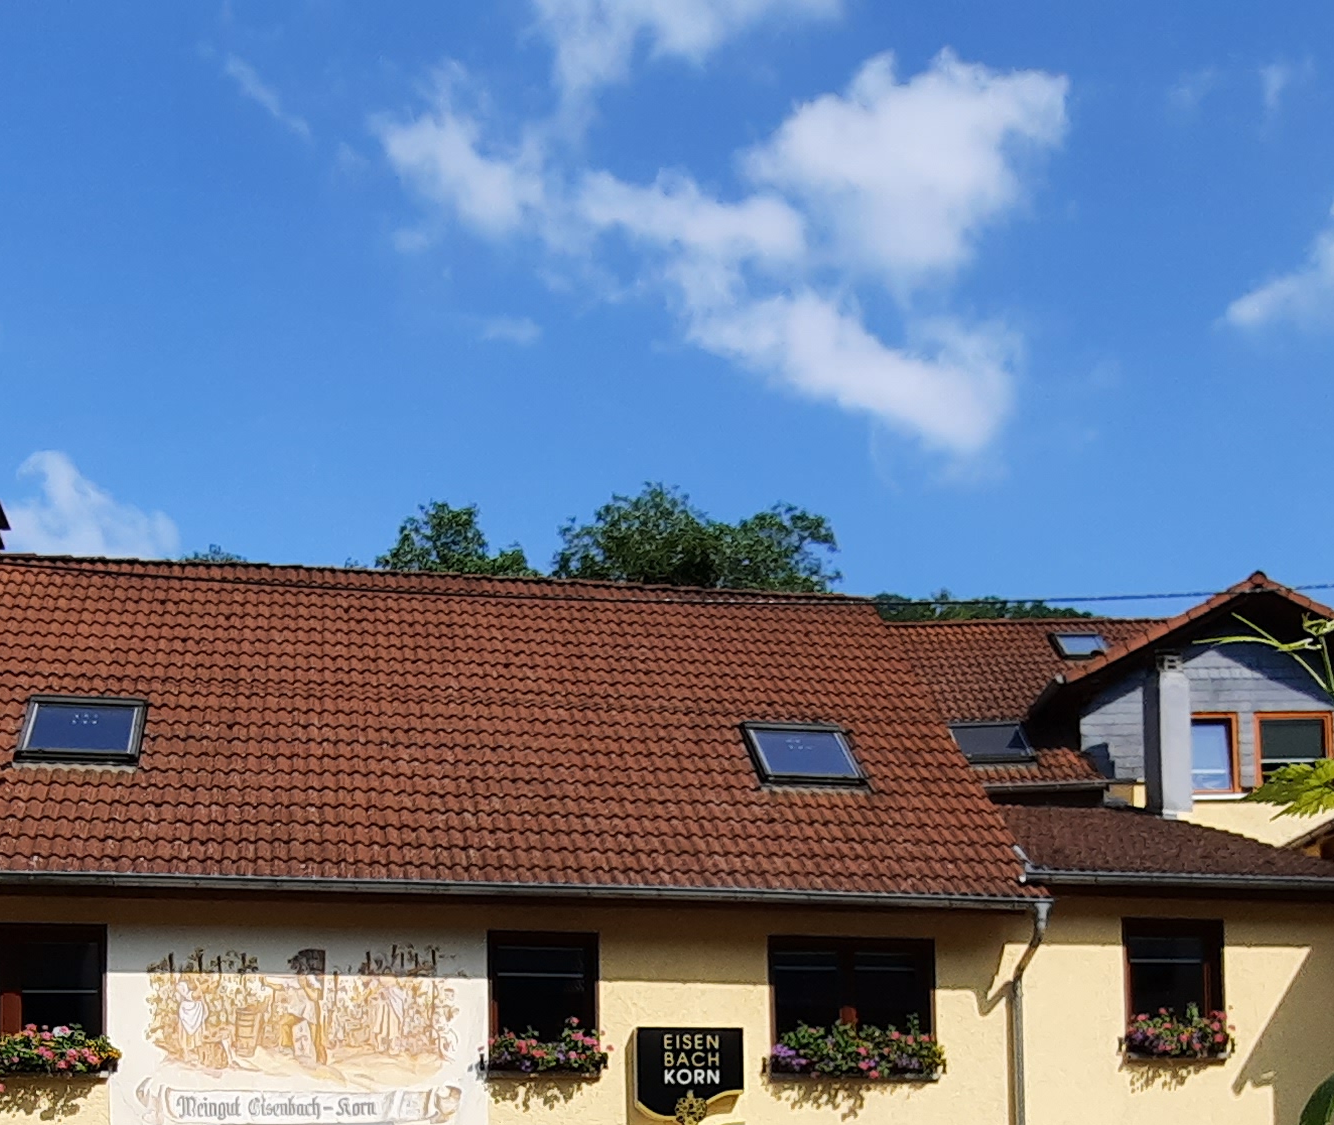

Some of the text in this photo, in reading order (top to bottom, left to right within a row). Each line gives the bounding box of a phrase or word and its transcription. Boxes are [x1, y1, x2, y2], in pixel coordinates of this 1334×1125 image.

[663, 1034, 720, 1050] EISEN
[663, 1052, 720, 1067] BACH
[663, 1068, 720, 1085] KORN
[176, 1095, 241, 1120] Weingut
